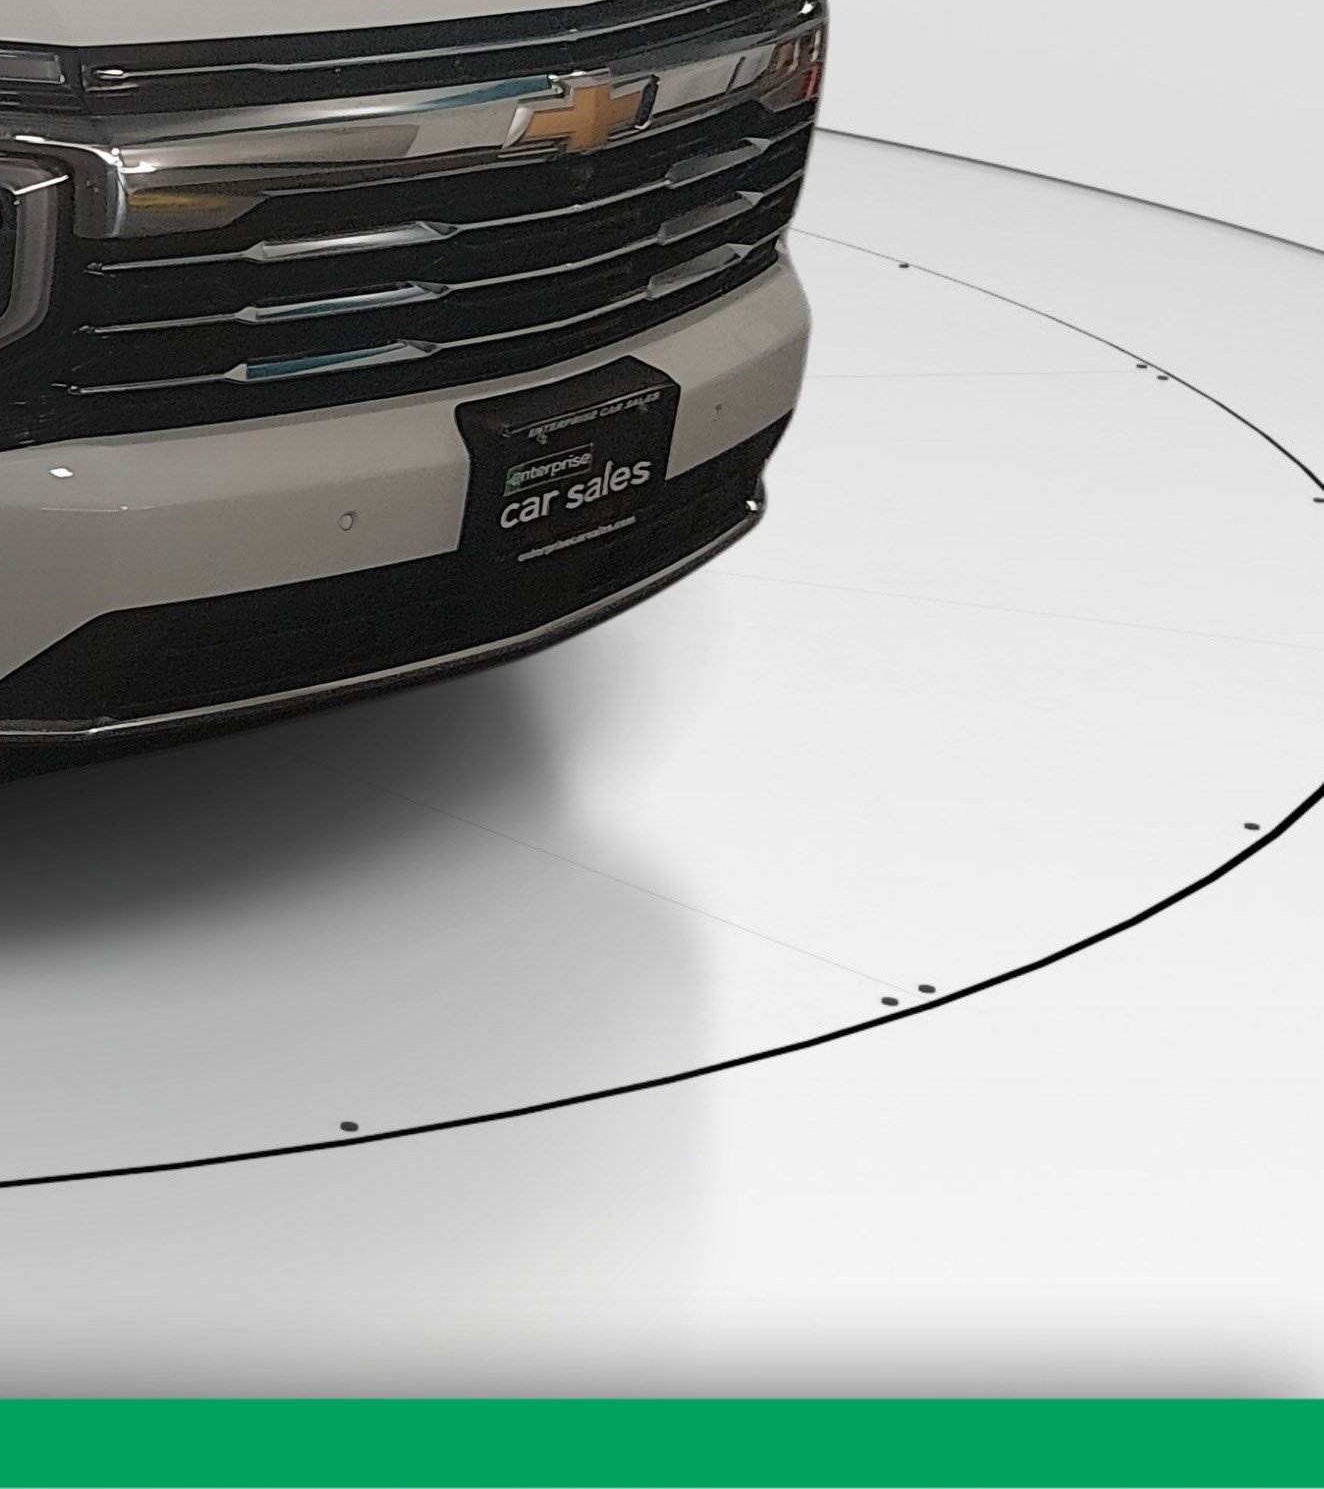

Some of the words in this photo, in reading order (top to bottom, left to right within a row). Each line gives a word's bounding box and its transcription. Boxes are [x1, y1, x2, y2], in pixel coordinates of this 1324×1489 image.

[500, 489, 560, 529] car
[565, 459, 653, 510] sales
[508, 452, 592, 486] enterprise
